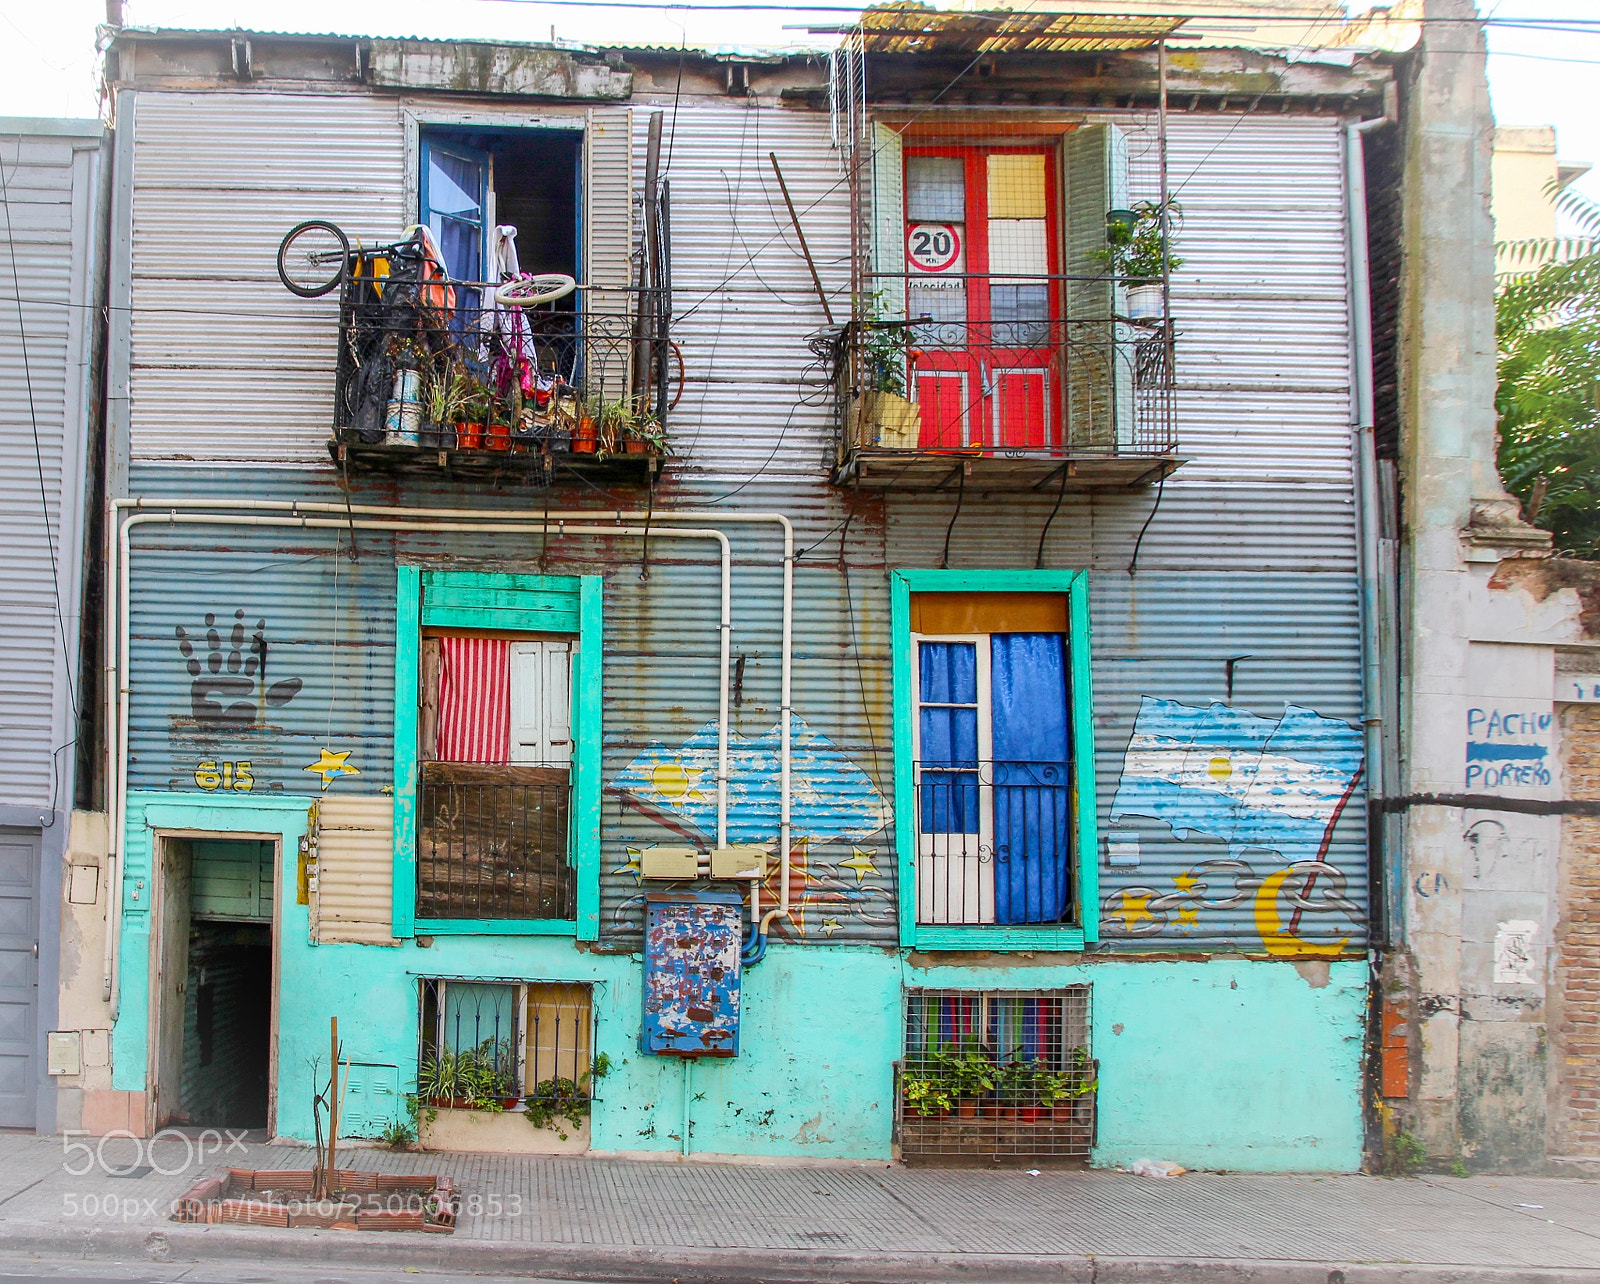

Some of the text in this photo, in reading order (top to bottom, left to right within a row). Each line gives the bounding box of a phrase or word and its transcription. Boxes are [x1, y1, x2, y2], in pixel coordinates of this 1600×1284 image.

[913, 231, 951, 256] 20
[194, 761, 255, 792] 615
[1465, 762, 1552, 789] PORTERO
